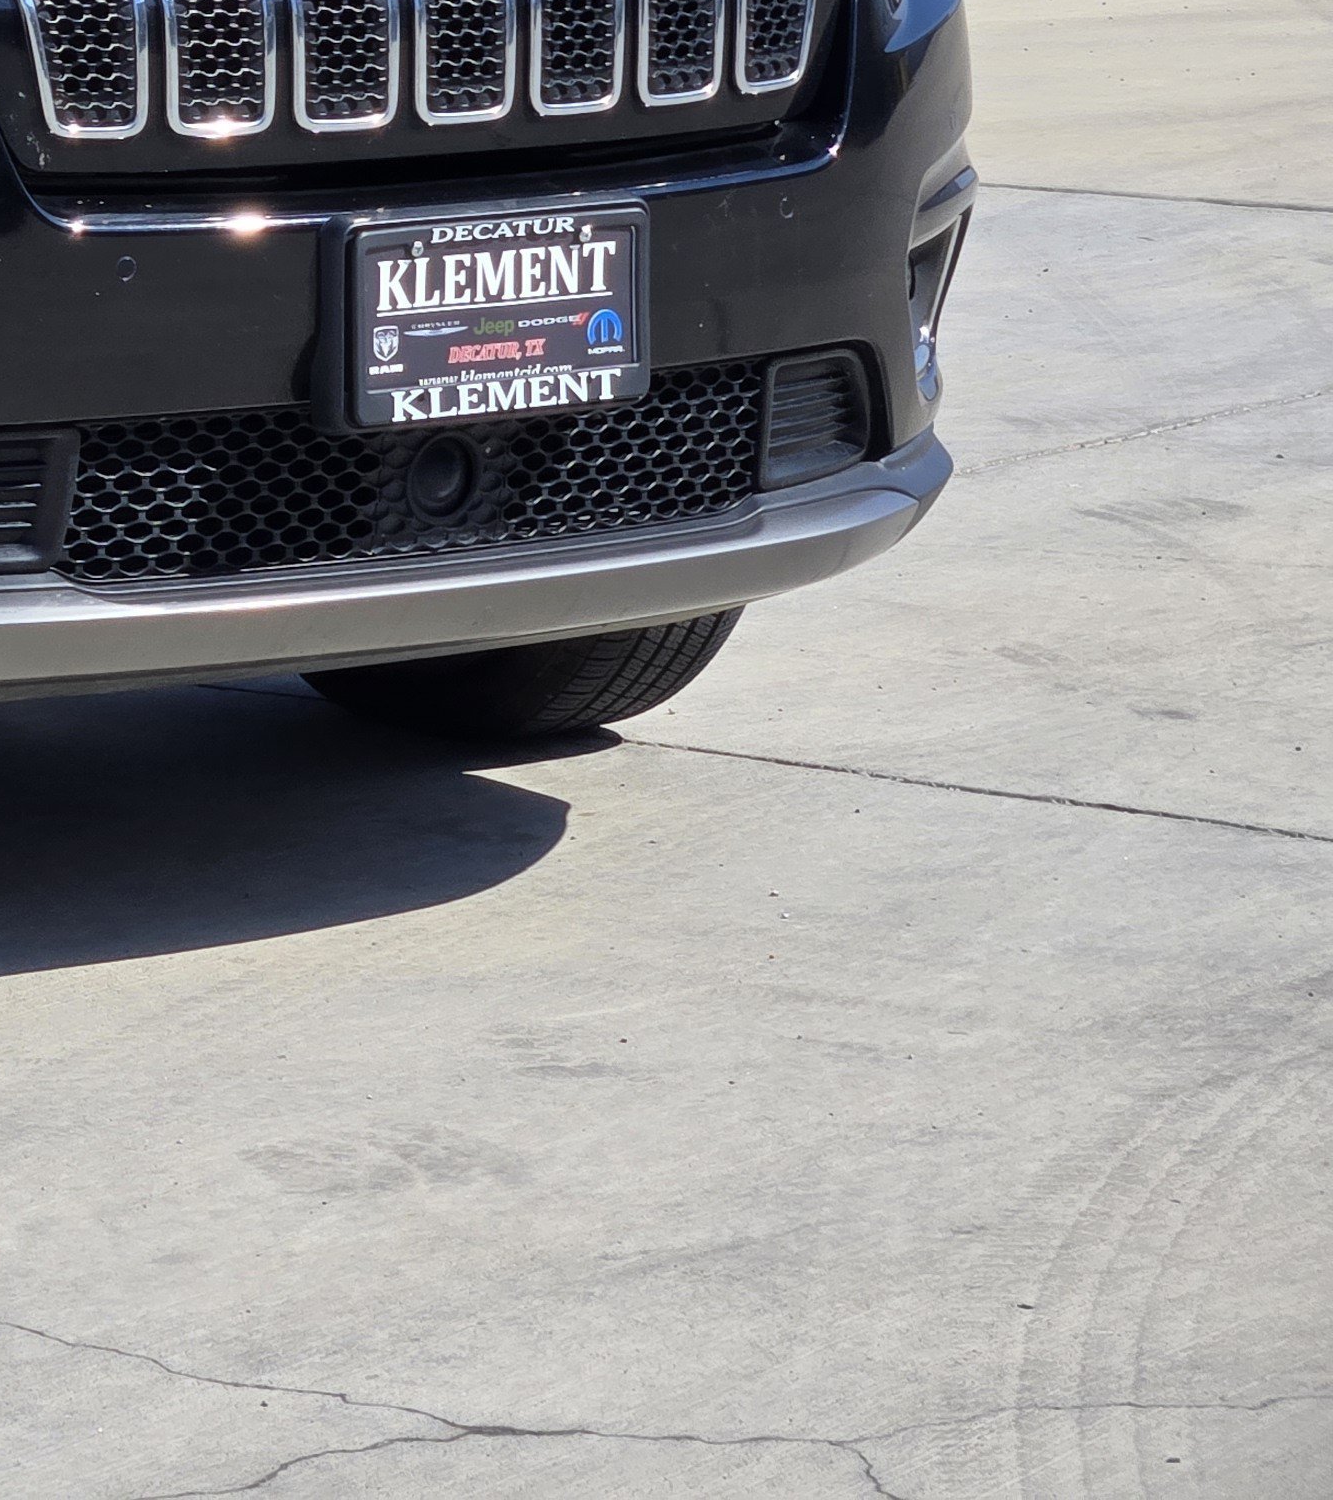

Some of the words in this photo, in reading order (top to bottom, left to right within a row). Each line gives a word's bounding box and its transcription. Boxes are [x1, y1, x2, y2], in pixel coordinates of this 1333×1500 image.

[430, 216, 575, 244] DECATUR
[375, 240, 617, 313] KLEMENT
[473, 317, 515, 337] Jeep
[518, 314, 582, 329] DODGE
[447, 340, 522, 364] DECATUR,
[525, 338, 546, 357] TX
[369, 364, 404, 375] RAM
[391, 368, 621, 423] KLEMENT
